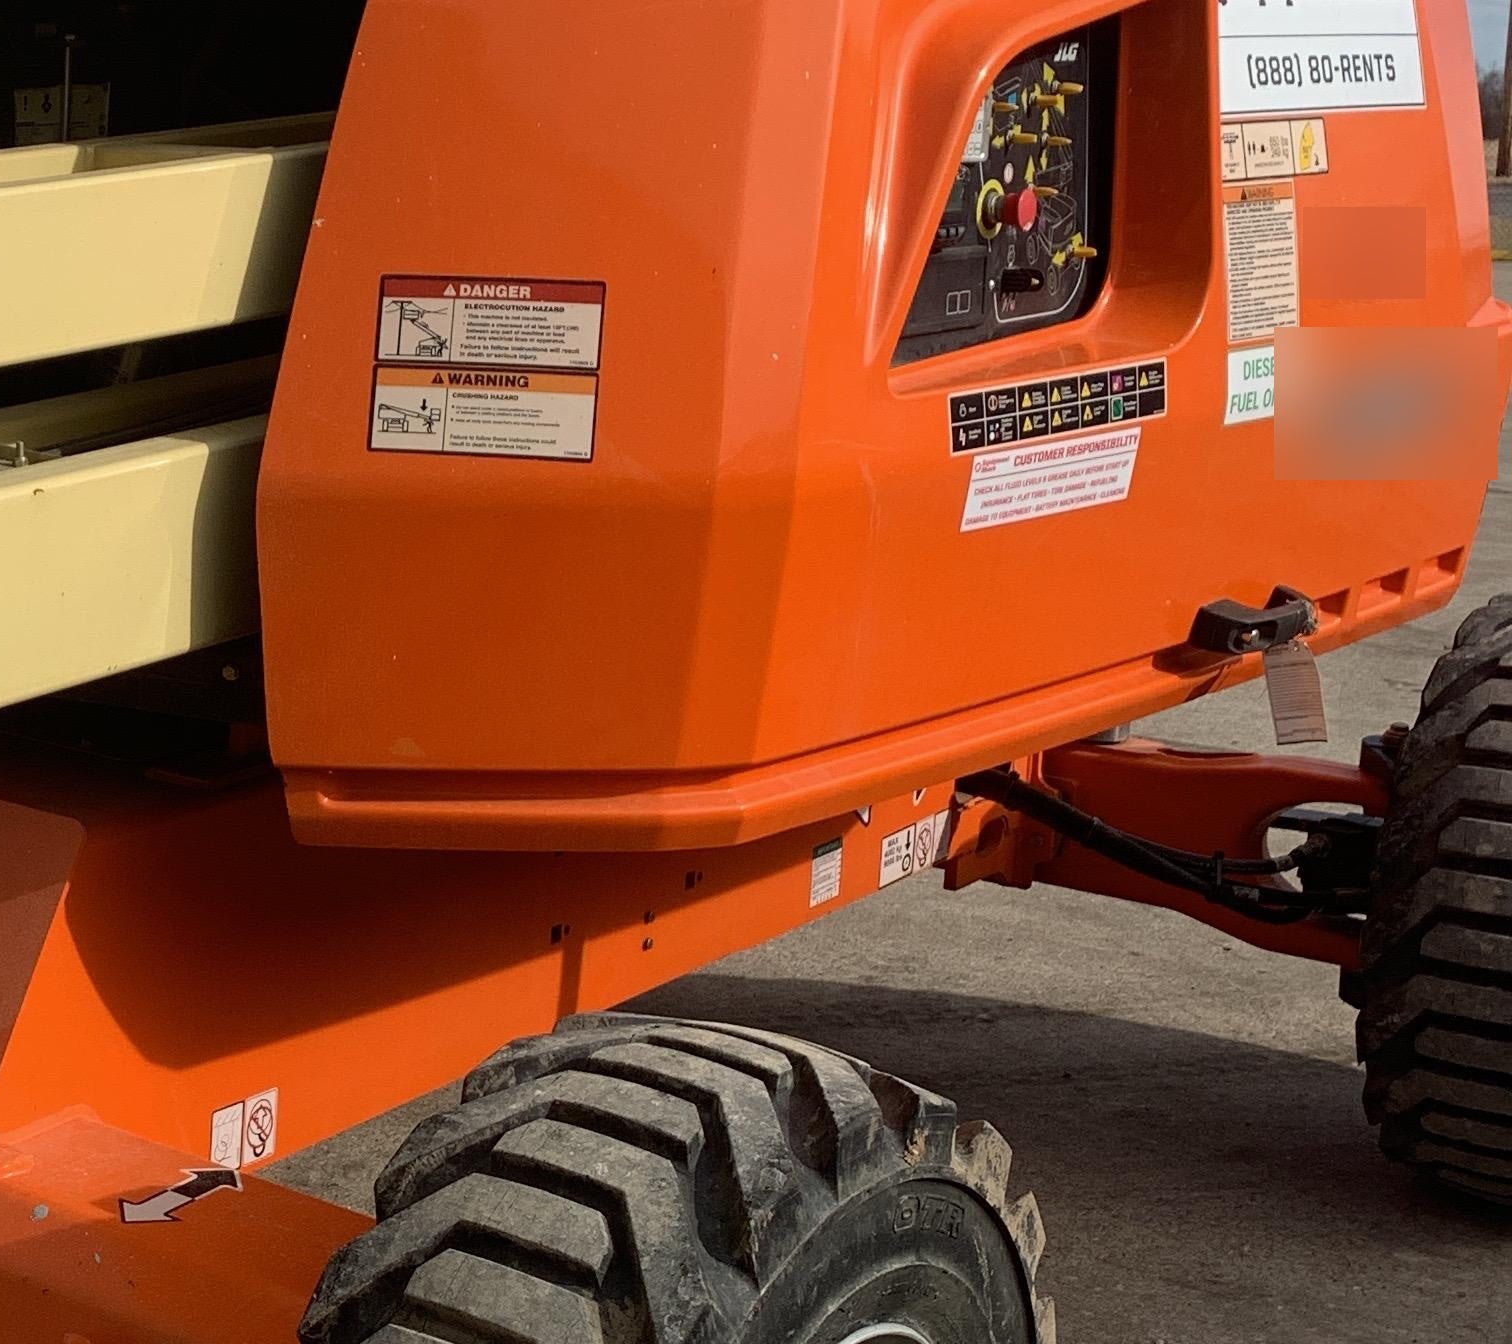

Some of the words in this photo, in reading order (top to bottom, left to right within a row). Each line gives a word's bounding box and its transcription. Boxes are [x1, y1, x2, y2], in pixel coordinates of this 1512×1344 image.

[1054, 41, 1080, 62] JLG
[1247, 53, 1303, 89] (888)
[1308, 54, 1396, 83] 80-RENTS
[459, 283, 531, 299] DANGER
[464, 303, 530, 312] ELECTROCUTION
[448, 373, 528, 388] WARNING
[1243, 357, 1274, 381] DIESE
[1229, 391, 1259, 414] FUEL
[1014, 446, 1064, 467] CUSTOMER
[1066, 434, 1138, 457] RESPONSIBILITY
[892, 1193, 965, 1239] OTR
